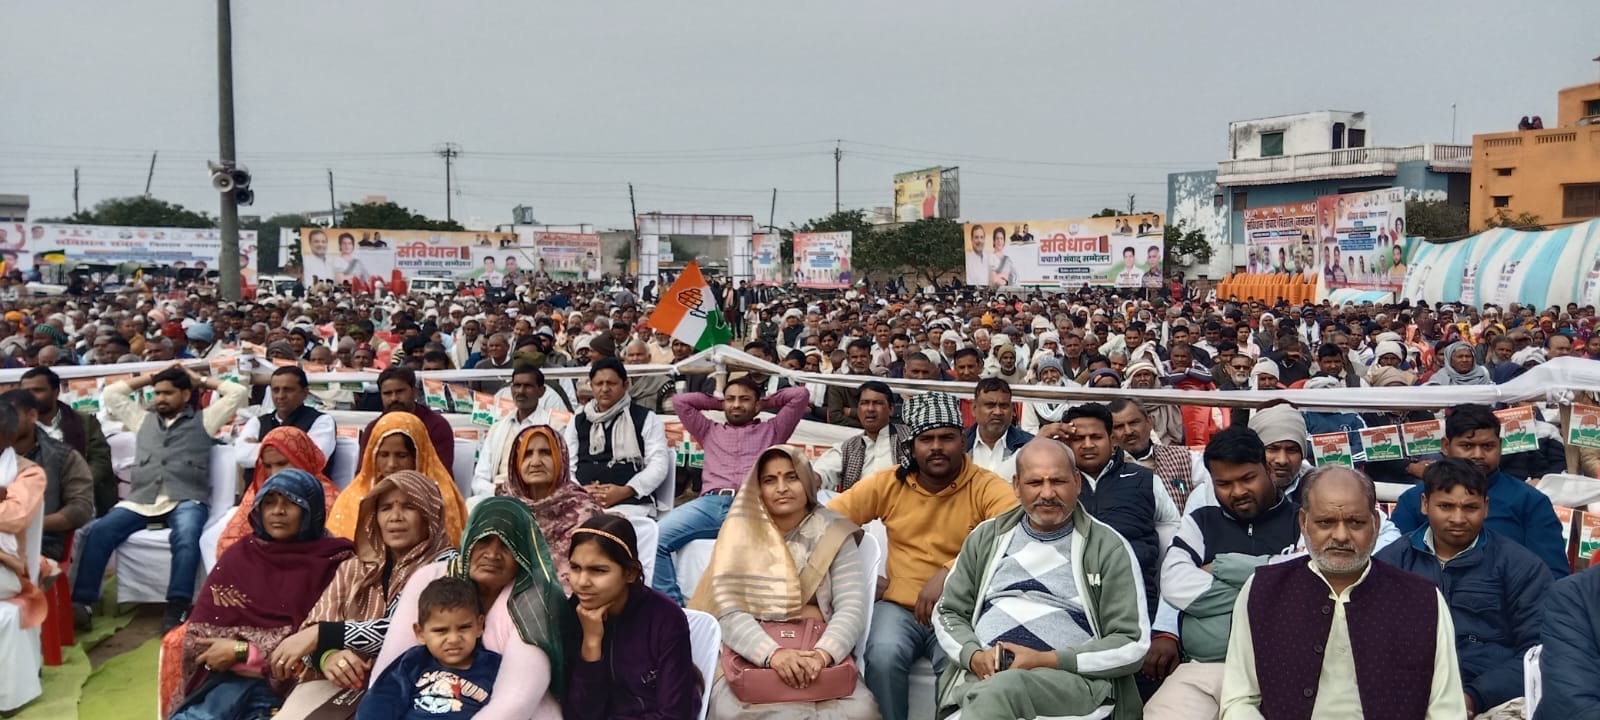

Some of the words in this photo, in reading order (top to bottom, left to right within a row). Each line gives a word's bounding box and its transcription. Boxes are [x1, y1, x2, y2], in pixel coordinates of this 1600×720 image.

[397, 241, 458, 258] संविधान
[1040, 233, 1098, 253] संविधान
[1041, 254, 1062, 263] बचाओ
[1063, 254, 1081, 264] संवाद
[1082, 253, 1110, 263] सम्मेलन
